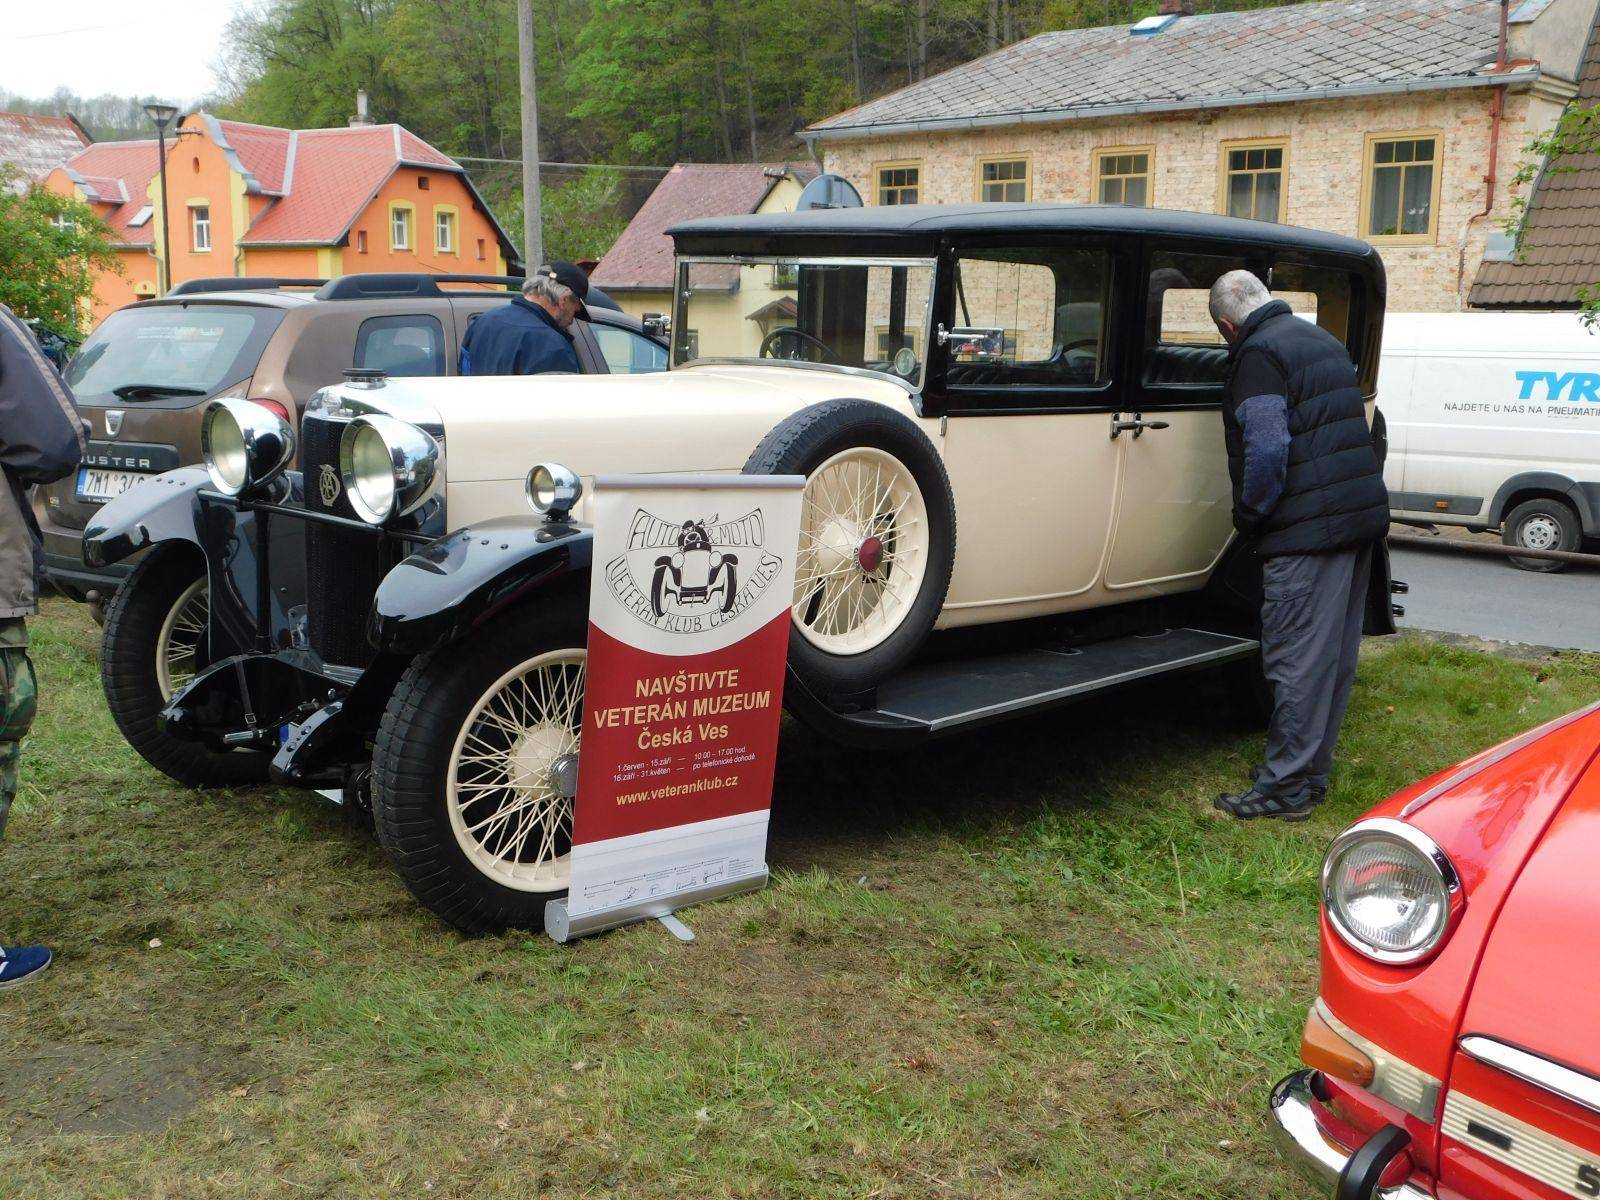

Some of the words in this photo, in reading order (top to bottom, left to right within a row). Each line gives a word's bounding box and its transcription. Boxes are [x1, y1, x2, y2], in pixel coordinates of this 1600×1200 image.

[1515, 371, 1600, 402] TYR
[1444, 402, 1490, 412] NAJDETE
[1493, 403, 1500, 413] U
[1503, 402, 1525, 414] NÁS
[1528, 404, 1543, 414] NA
[628, 515, 681, 549] AUTO
[719, 514, 763, 547] MOTO
[664, 614, 702, 632] KLUB
[635, 669, 739, 698] NAVŠTIVTE
[594, 698, 687, 729] VETERÁN
[692, 690, 771, 717] MUZEUM
[637, 725, 693, 750] Česká
[698, 722, 729, 742] Ves
[616, 775, 739, 806] www.veteranklub.cz
